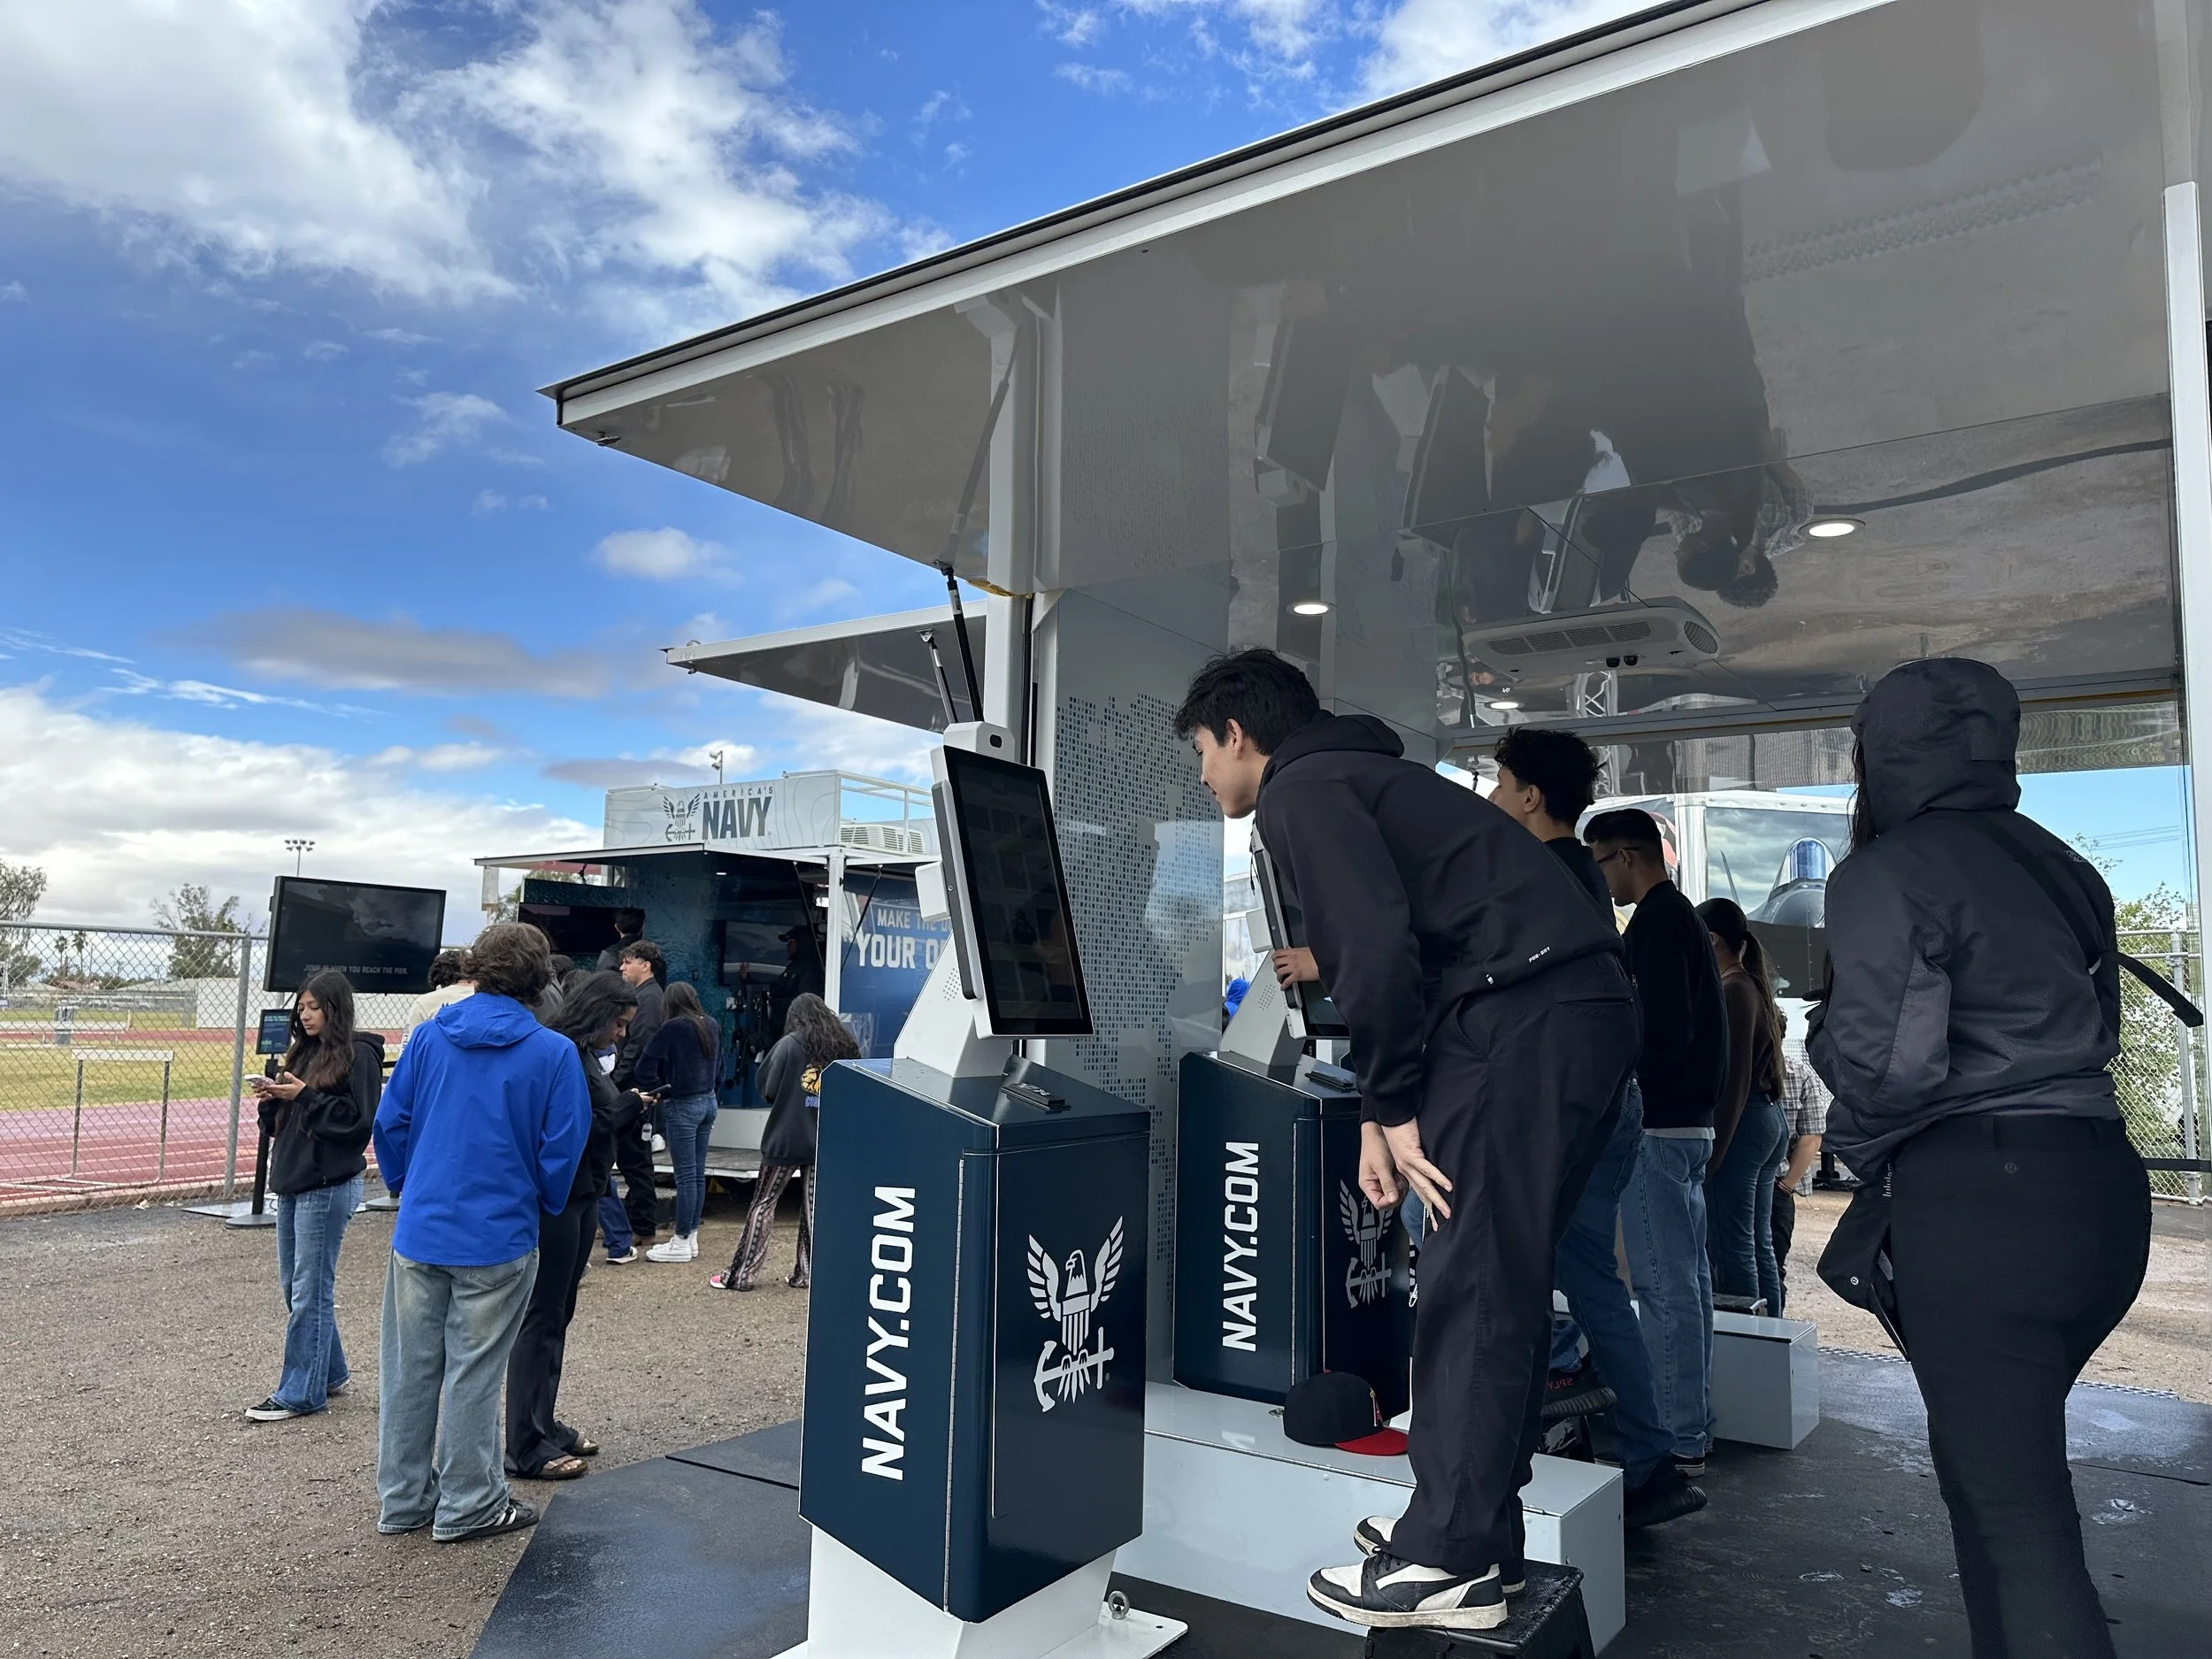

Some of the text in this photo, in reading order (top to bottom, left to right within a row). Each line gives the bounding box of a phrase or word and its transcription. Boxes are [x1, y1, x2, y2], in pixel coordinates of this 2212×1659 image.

[703, 786, 773, 799] AMERICA'S
[702, 796, 772, 840] NAVY
[877, 909, 910, 929] MAKE
[856, 933, 916, 969] YOUR
[1222, 1141, 1259, 1352] NAVY.COM
[861, 1186, 916, 1481] NAVY.COM
